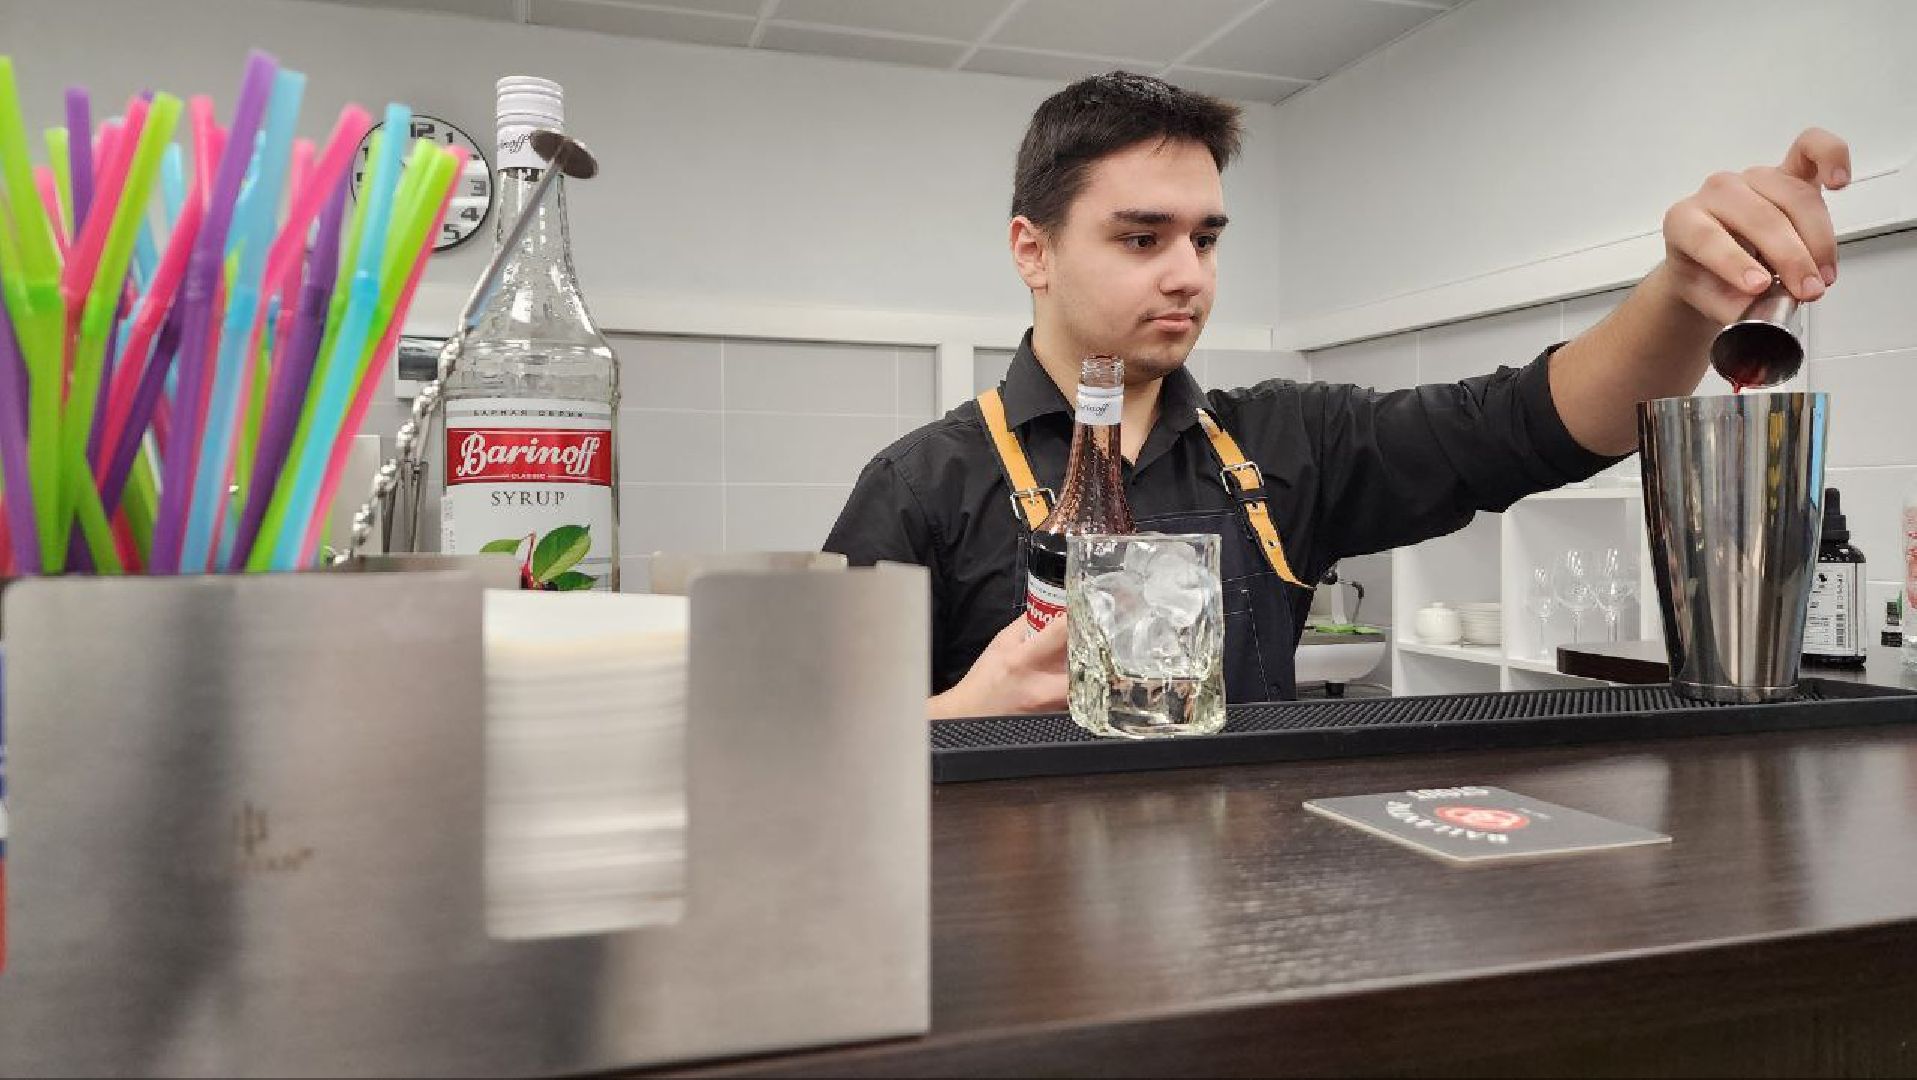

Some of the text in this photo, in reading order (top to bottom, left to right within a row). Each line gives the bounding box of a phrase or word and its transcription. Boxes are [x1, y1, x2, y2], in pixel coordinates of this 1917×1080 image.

[471, 179, 486, 196] 3
[461, 207, 479, 221] 4
[444, 223, 460, 240] 5
[455, 431, 601, 477] Barinoff
[491, 490, 565, 507] SYRUP
